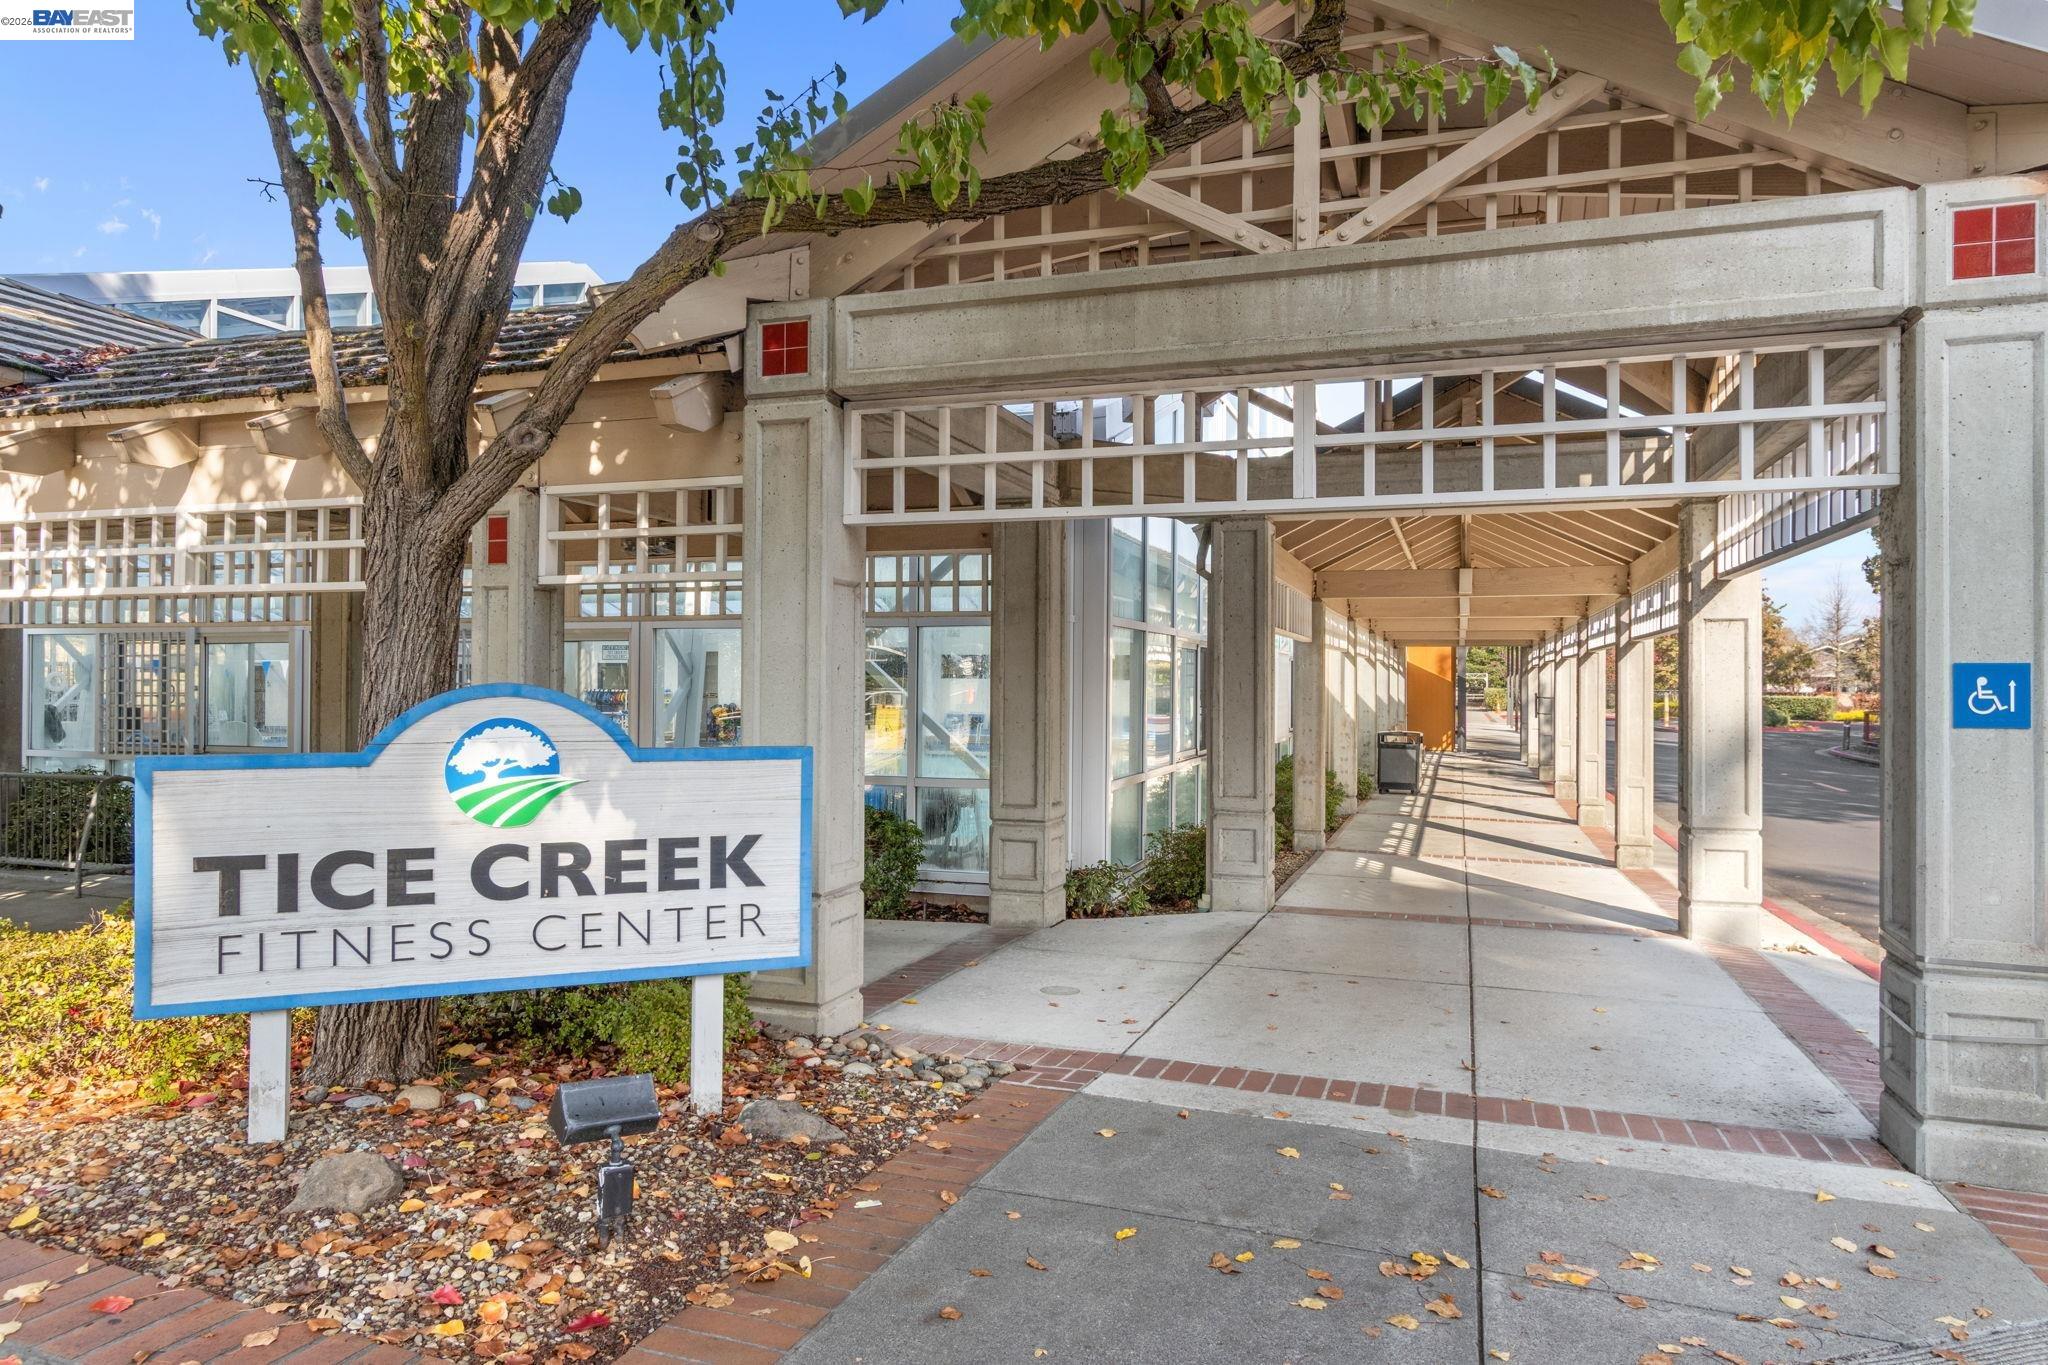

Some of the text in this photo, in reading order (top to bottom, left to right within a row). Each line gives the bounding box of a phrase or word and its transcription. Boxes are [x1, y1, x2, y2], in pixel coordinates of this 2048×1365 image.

[193, 833, 765, 918] TICE CREEK
[217, 903, 766, 975] FITNESS CENTER
